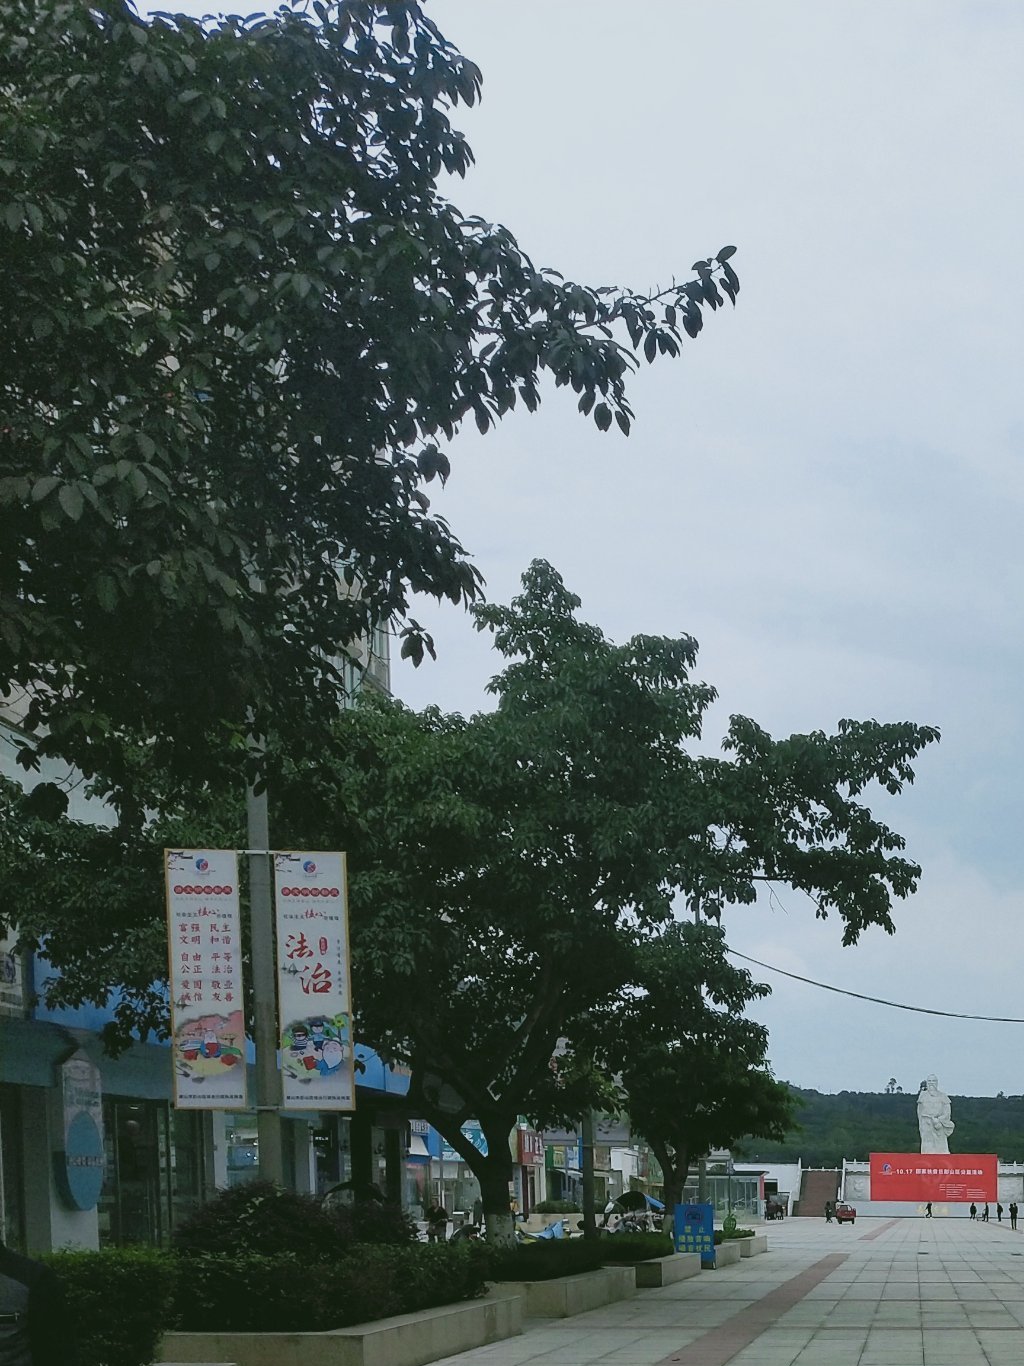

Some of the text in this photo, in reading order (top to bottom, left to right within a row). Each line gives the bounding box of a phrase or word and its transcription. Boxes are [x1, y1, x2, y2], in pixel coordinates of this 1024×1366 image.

[179, 923, 231, 932] 富强 民主
[180, 935, 231, 944] 文明 和谐
[181, 952, 232, 962] 自由 平等
[285, 932, 332, 994] 法治
[181, 965, 233, 973] 公正 法治
[182, 980, 234, 989] 爱国 敬业
[181, 993, 234, 1002] 诚信 友善
